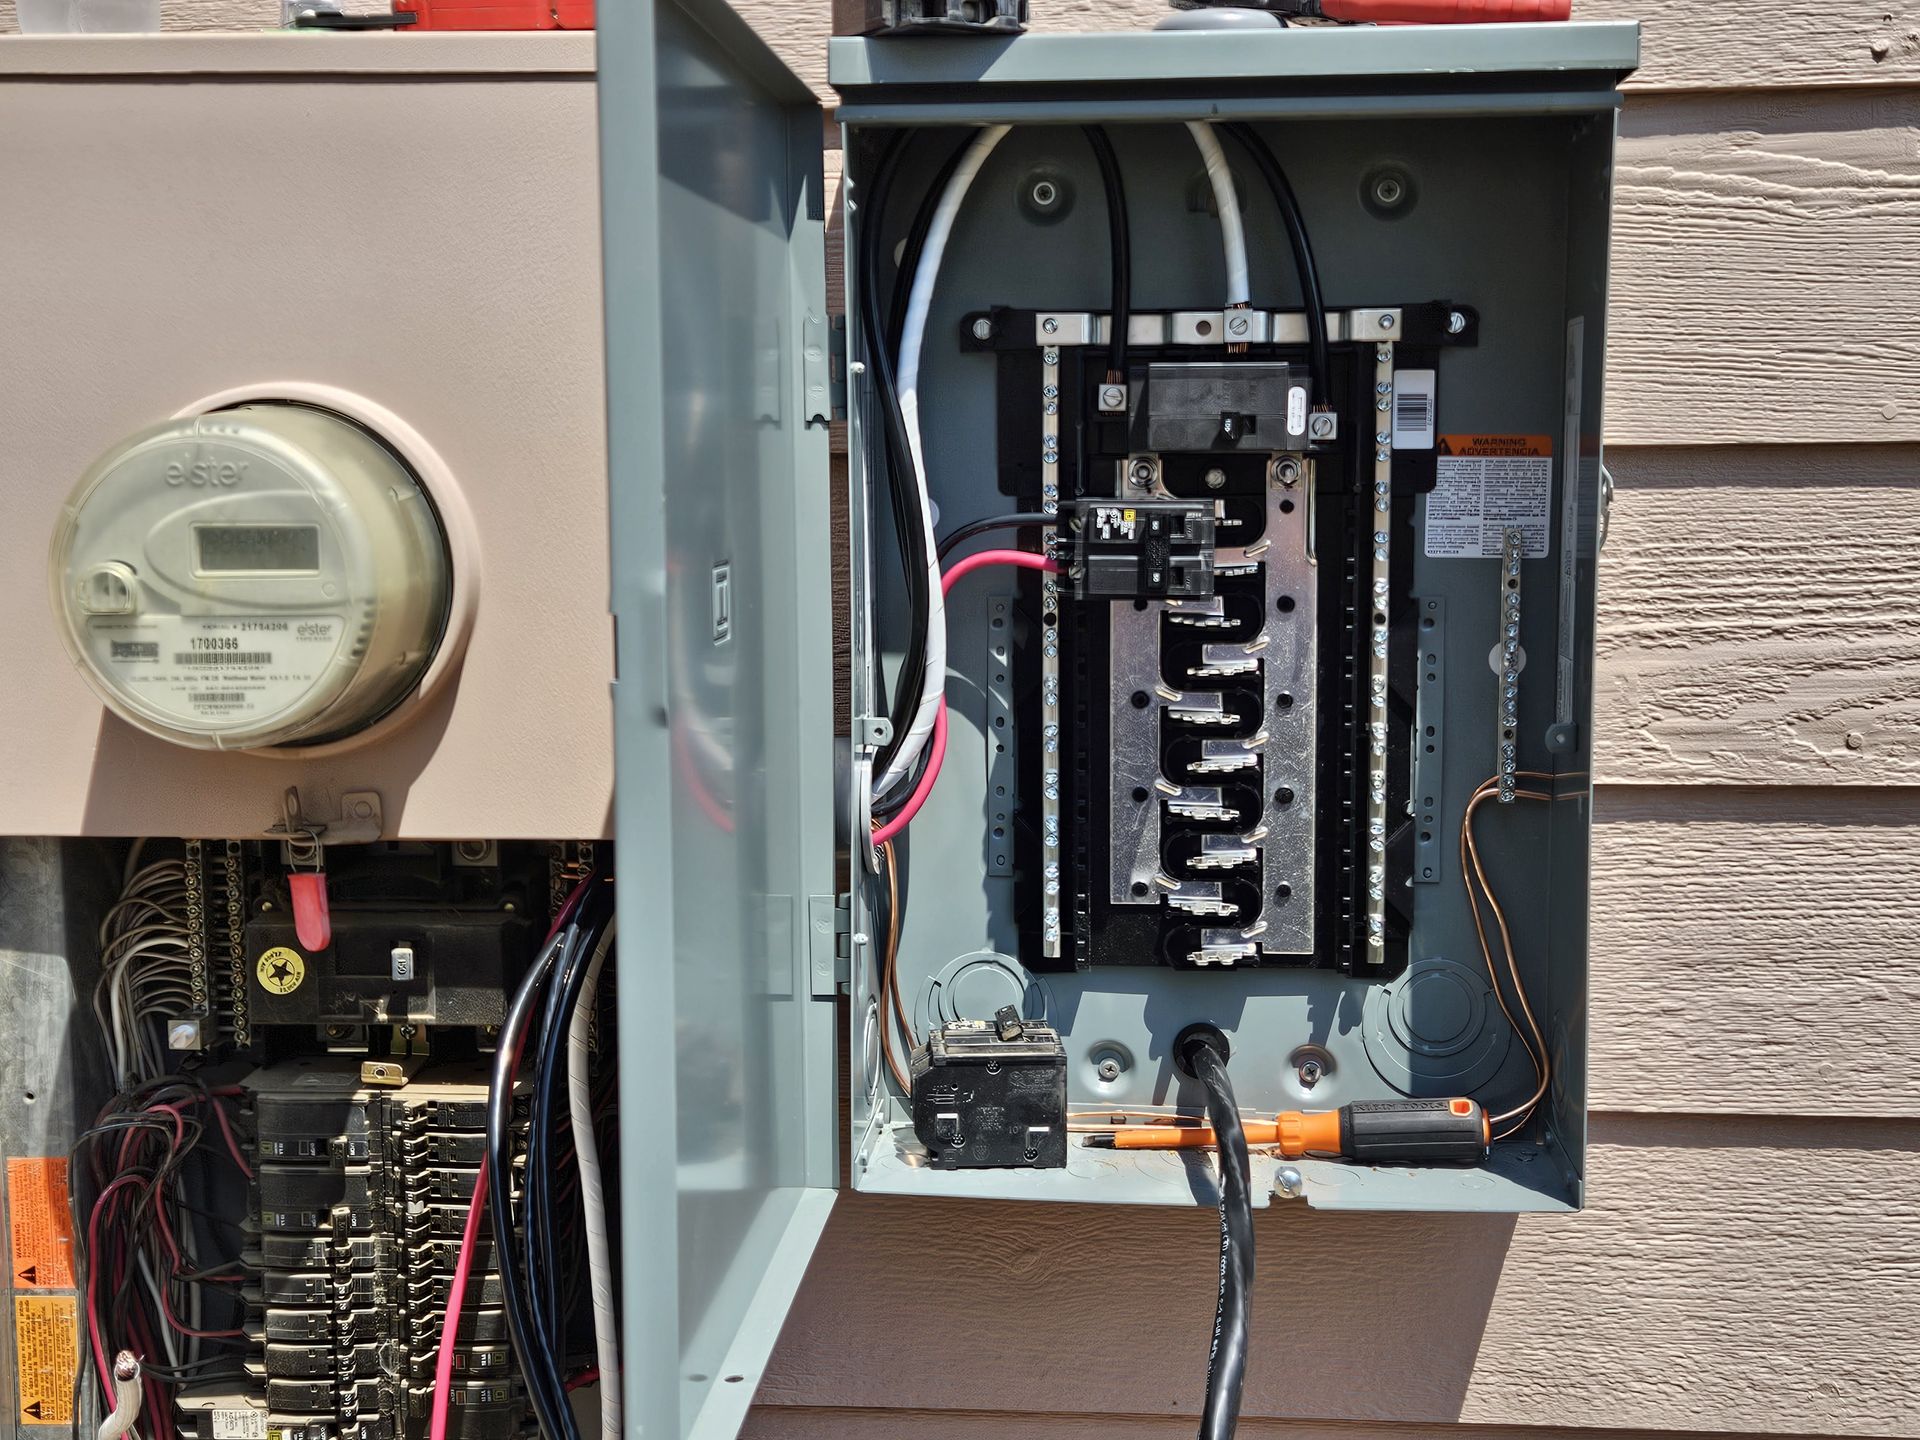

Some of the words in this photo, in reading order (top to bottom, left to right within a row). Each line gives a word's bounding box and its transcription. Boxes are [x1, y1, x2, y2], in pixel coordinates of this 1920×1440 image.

[1472, 438, 1526, 447] WARNING
[1458, 447, 1539, 456] ADVERTENCIA
[1354, 1102, 1397, 1111] KLEIN
[1401, 1102, 1448, 1110] TOOLS
